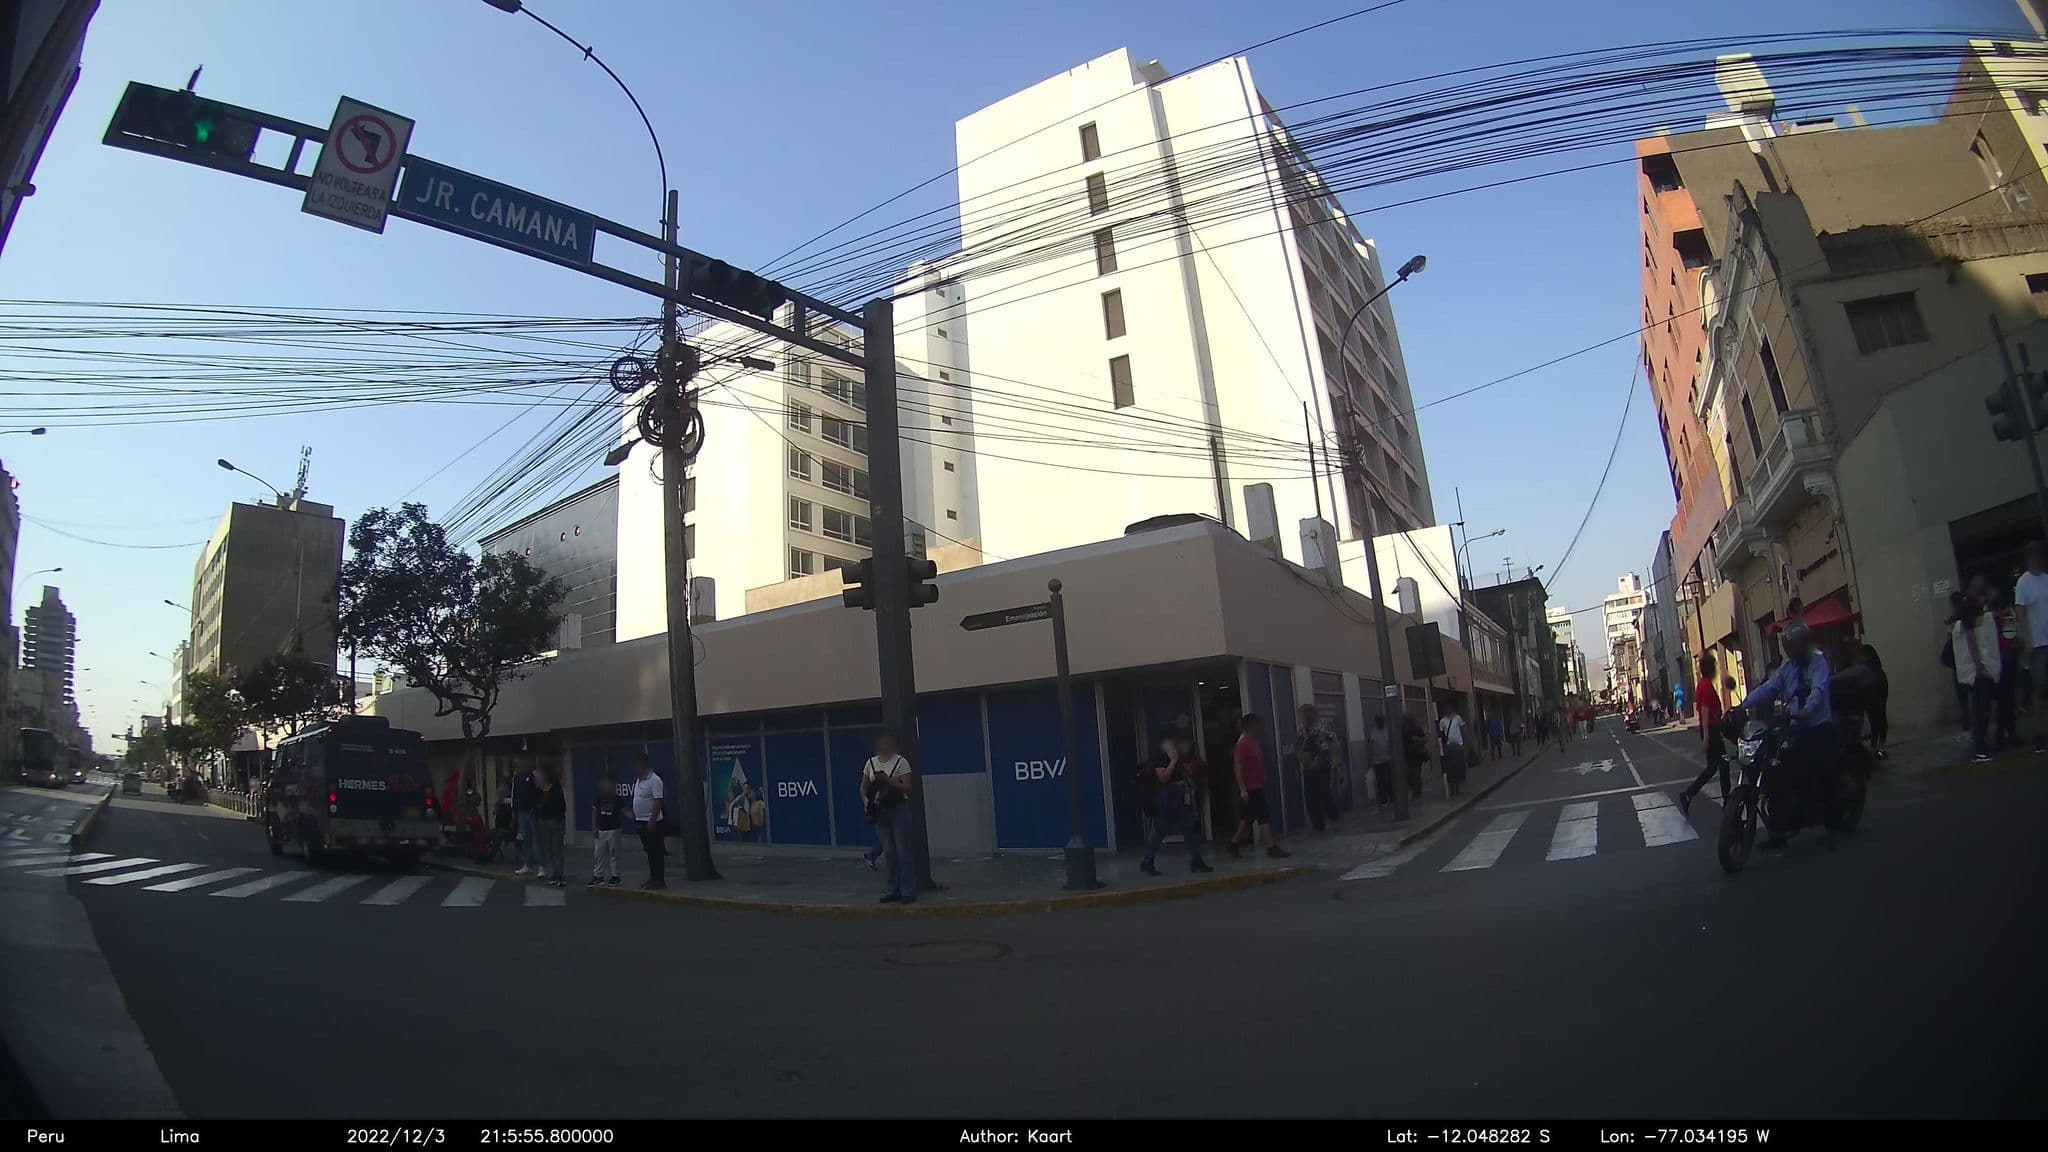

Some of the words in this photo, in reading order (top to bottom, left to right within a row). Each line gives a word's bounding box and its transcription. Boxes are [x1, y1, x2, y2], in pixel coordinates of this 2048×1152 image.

[316, 172, 333, 186] NO
[312, 191, 325, 203] LA
[415, 177, 460, 213] JR.
[470, 192, 579, 251] CAMANA
[338, 778, 386, 791] HERMES
[616, 783, 635, 797] BBV
[777, 780, 818, 798] BBVA
